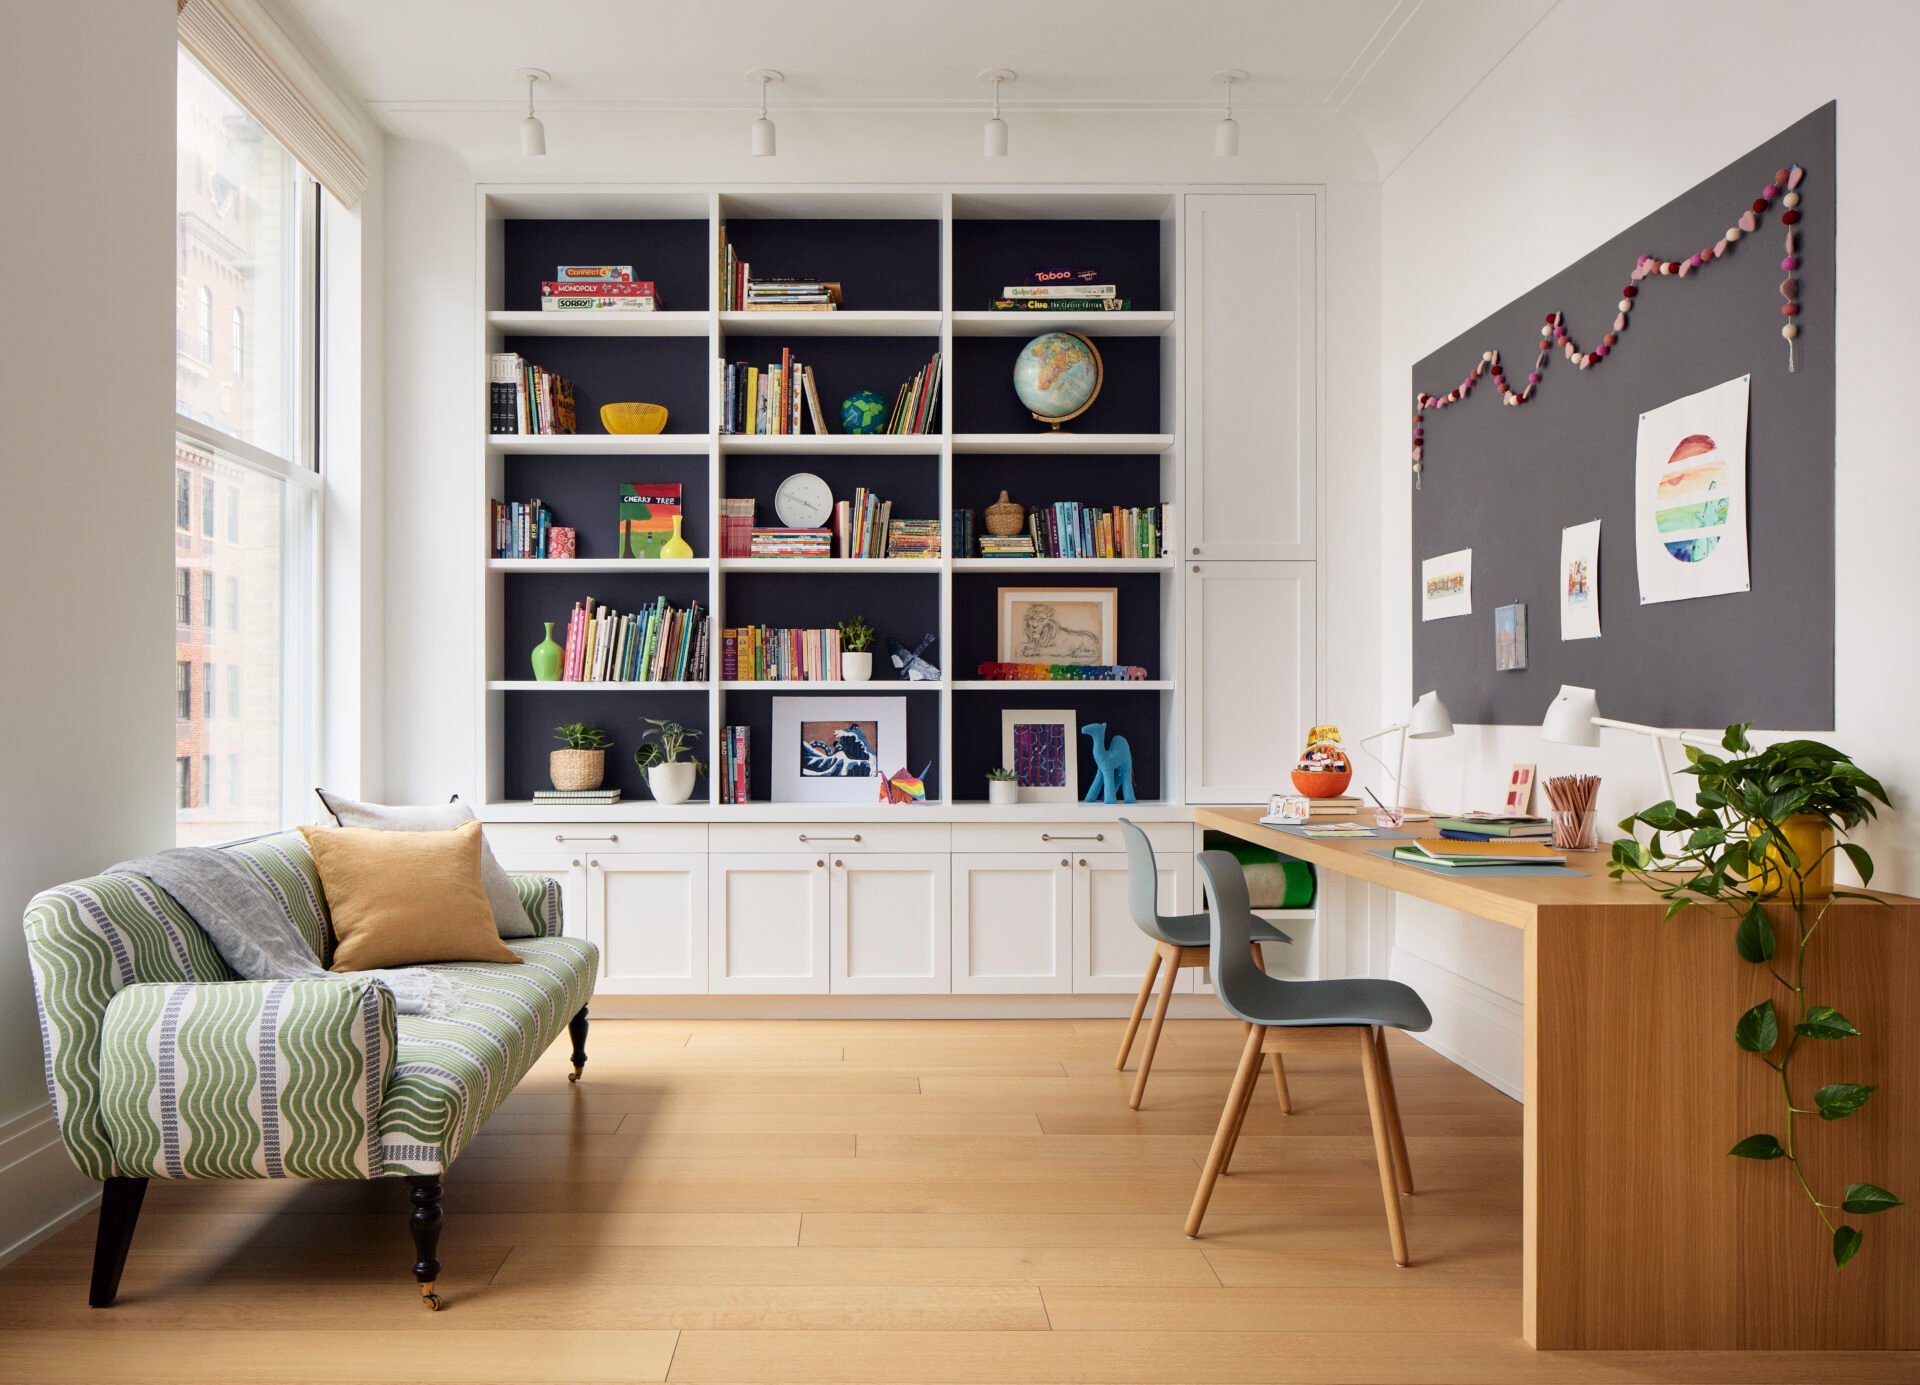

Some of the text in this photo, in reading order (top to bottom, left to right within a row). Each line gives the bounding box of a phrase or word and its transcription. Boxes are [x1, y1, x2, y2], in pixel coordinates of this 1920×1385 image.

[600, 268, 607, 276] 4
[1035, 271, 1071, 282] Taboo
[1028, 301, 1048, 309] Clue
